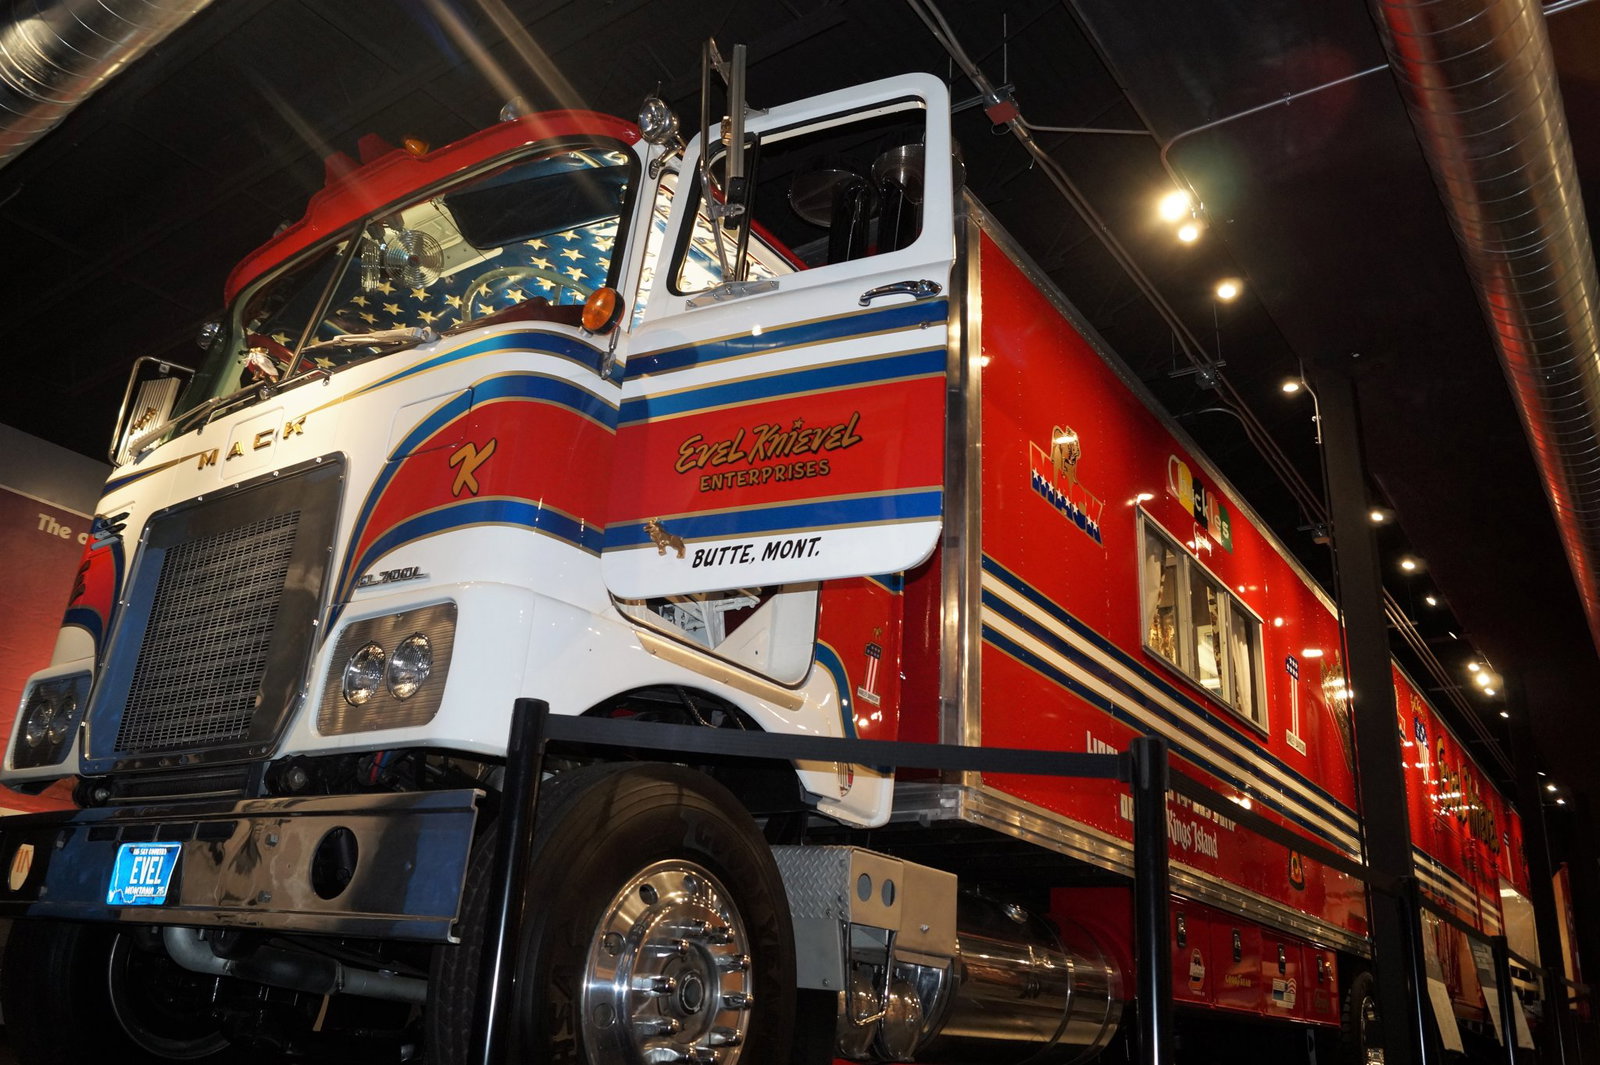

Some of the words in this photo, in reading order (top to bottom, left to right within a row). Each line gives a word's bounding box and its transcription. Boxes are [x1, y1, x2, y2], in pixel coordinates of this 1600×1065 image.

[198, 416, 306, 470] MACK
[675, 427, 747, 474] Evel
[747, 410, 863, 465] Knievel
[449, 431, 497, 497] K
[700, 459, 831, 493] ENTERPRISES
[37, 512, 72, 539] The
[692, 544, 755, 569] BUTTE,
[761, 536, 822, 562] MONT.
[1166, 807, 1192, 851] Kings
[1191, 820, 1219, 859] Island
[129, 856, 164, 885] EVEL
